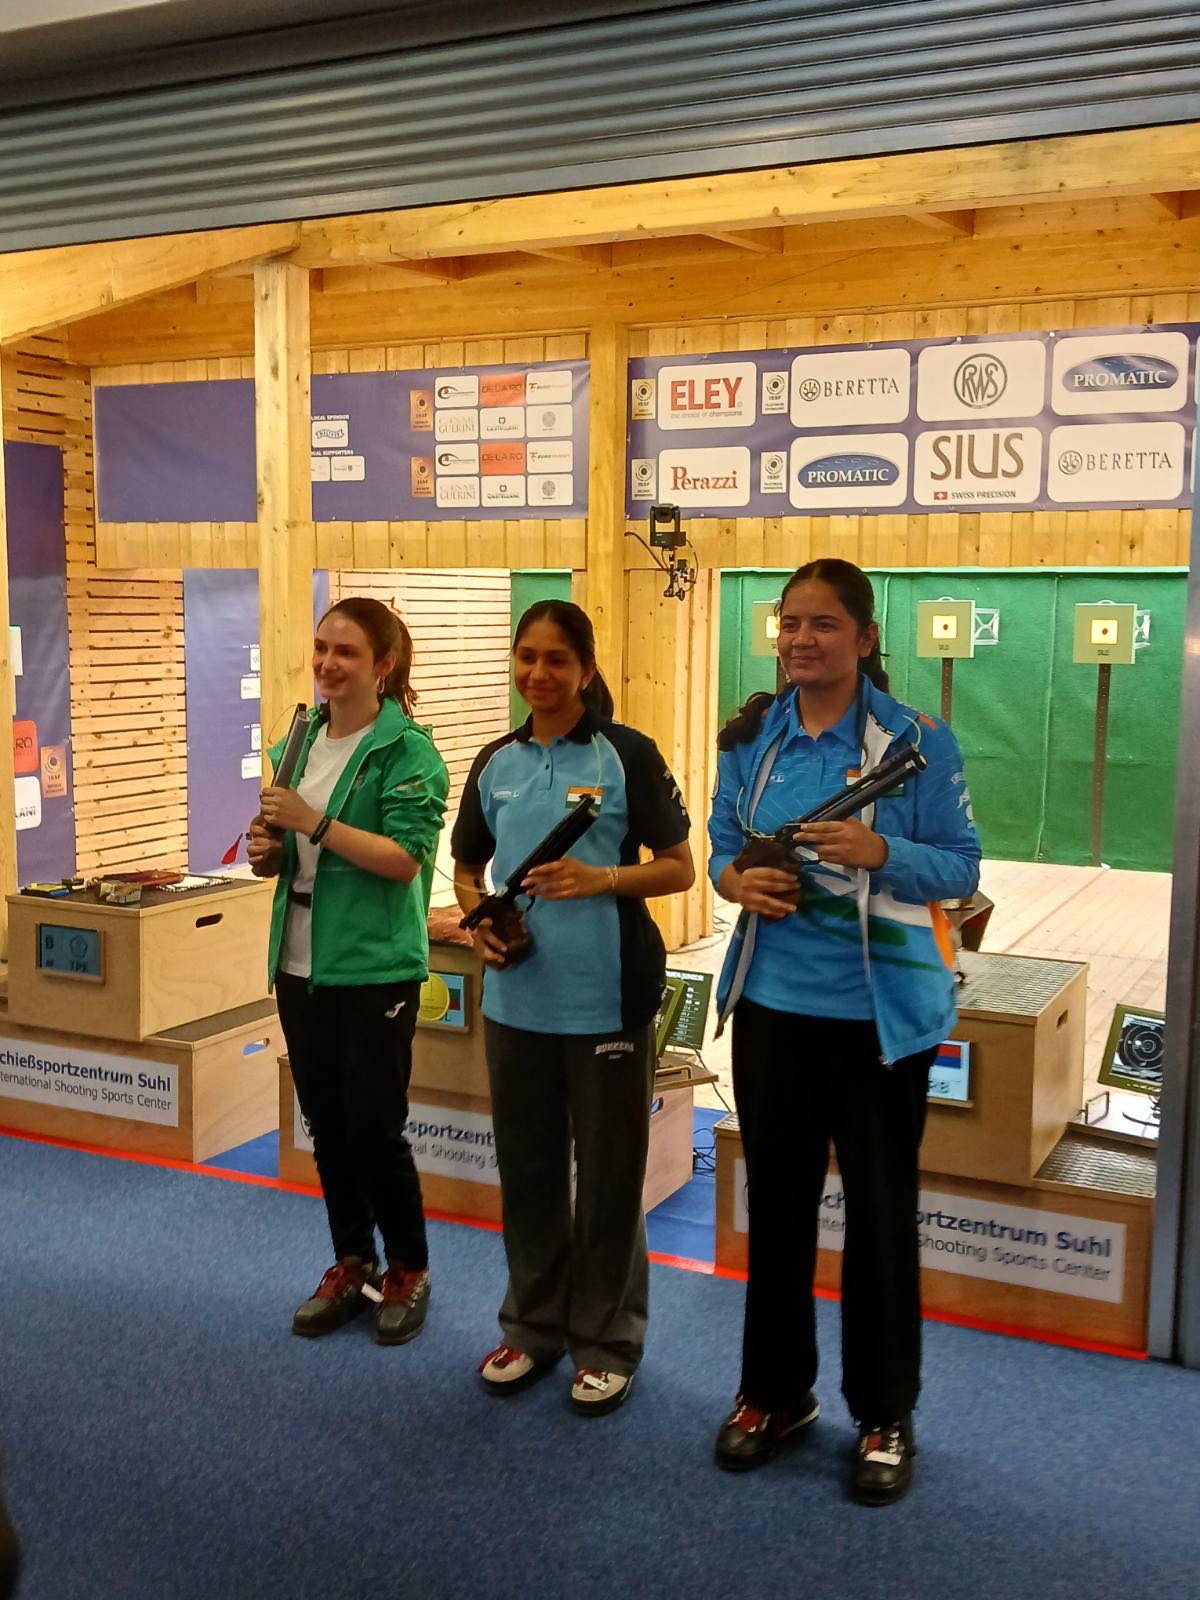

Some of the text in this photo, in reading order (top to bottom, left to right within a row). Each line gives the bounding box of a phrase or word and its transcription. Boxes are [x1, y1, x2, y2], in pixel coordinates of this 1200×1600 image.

[823, 377, 900, 398] BERETTA
[1073, 369, 1169, 388] PROMATIC
[670, 376, 743, 411] ELEY
[930, 432, 1024, 481] SIUS
[1086, 451, 1173, 471] BERETTA
[670, 466, 738, 491] Perazzi
[807, 468, 890, 484] PROMATIC
[951, 489, 1017, 500] SWISS PRECISION
[0, 1050, 171, 1092] chießsportzentrum Suhl
[0, 1071, 172, 1111] ternational Shooting Sports Center
[404, 1121, 497, 1148] sportzent
[917, 1210, 1113, 1258] ortzentrum Suhl
[992, 1246, 1049, 1271] Sports
[1053, 1257, 1112, 1282] Center
